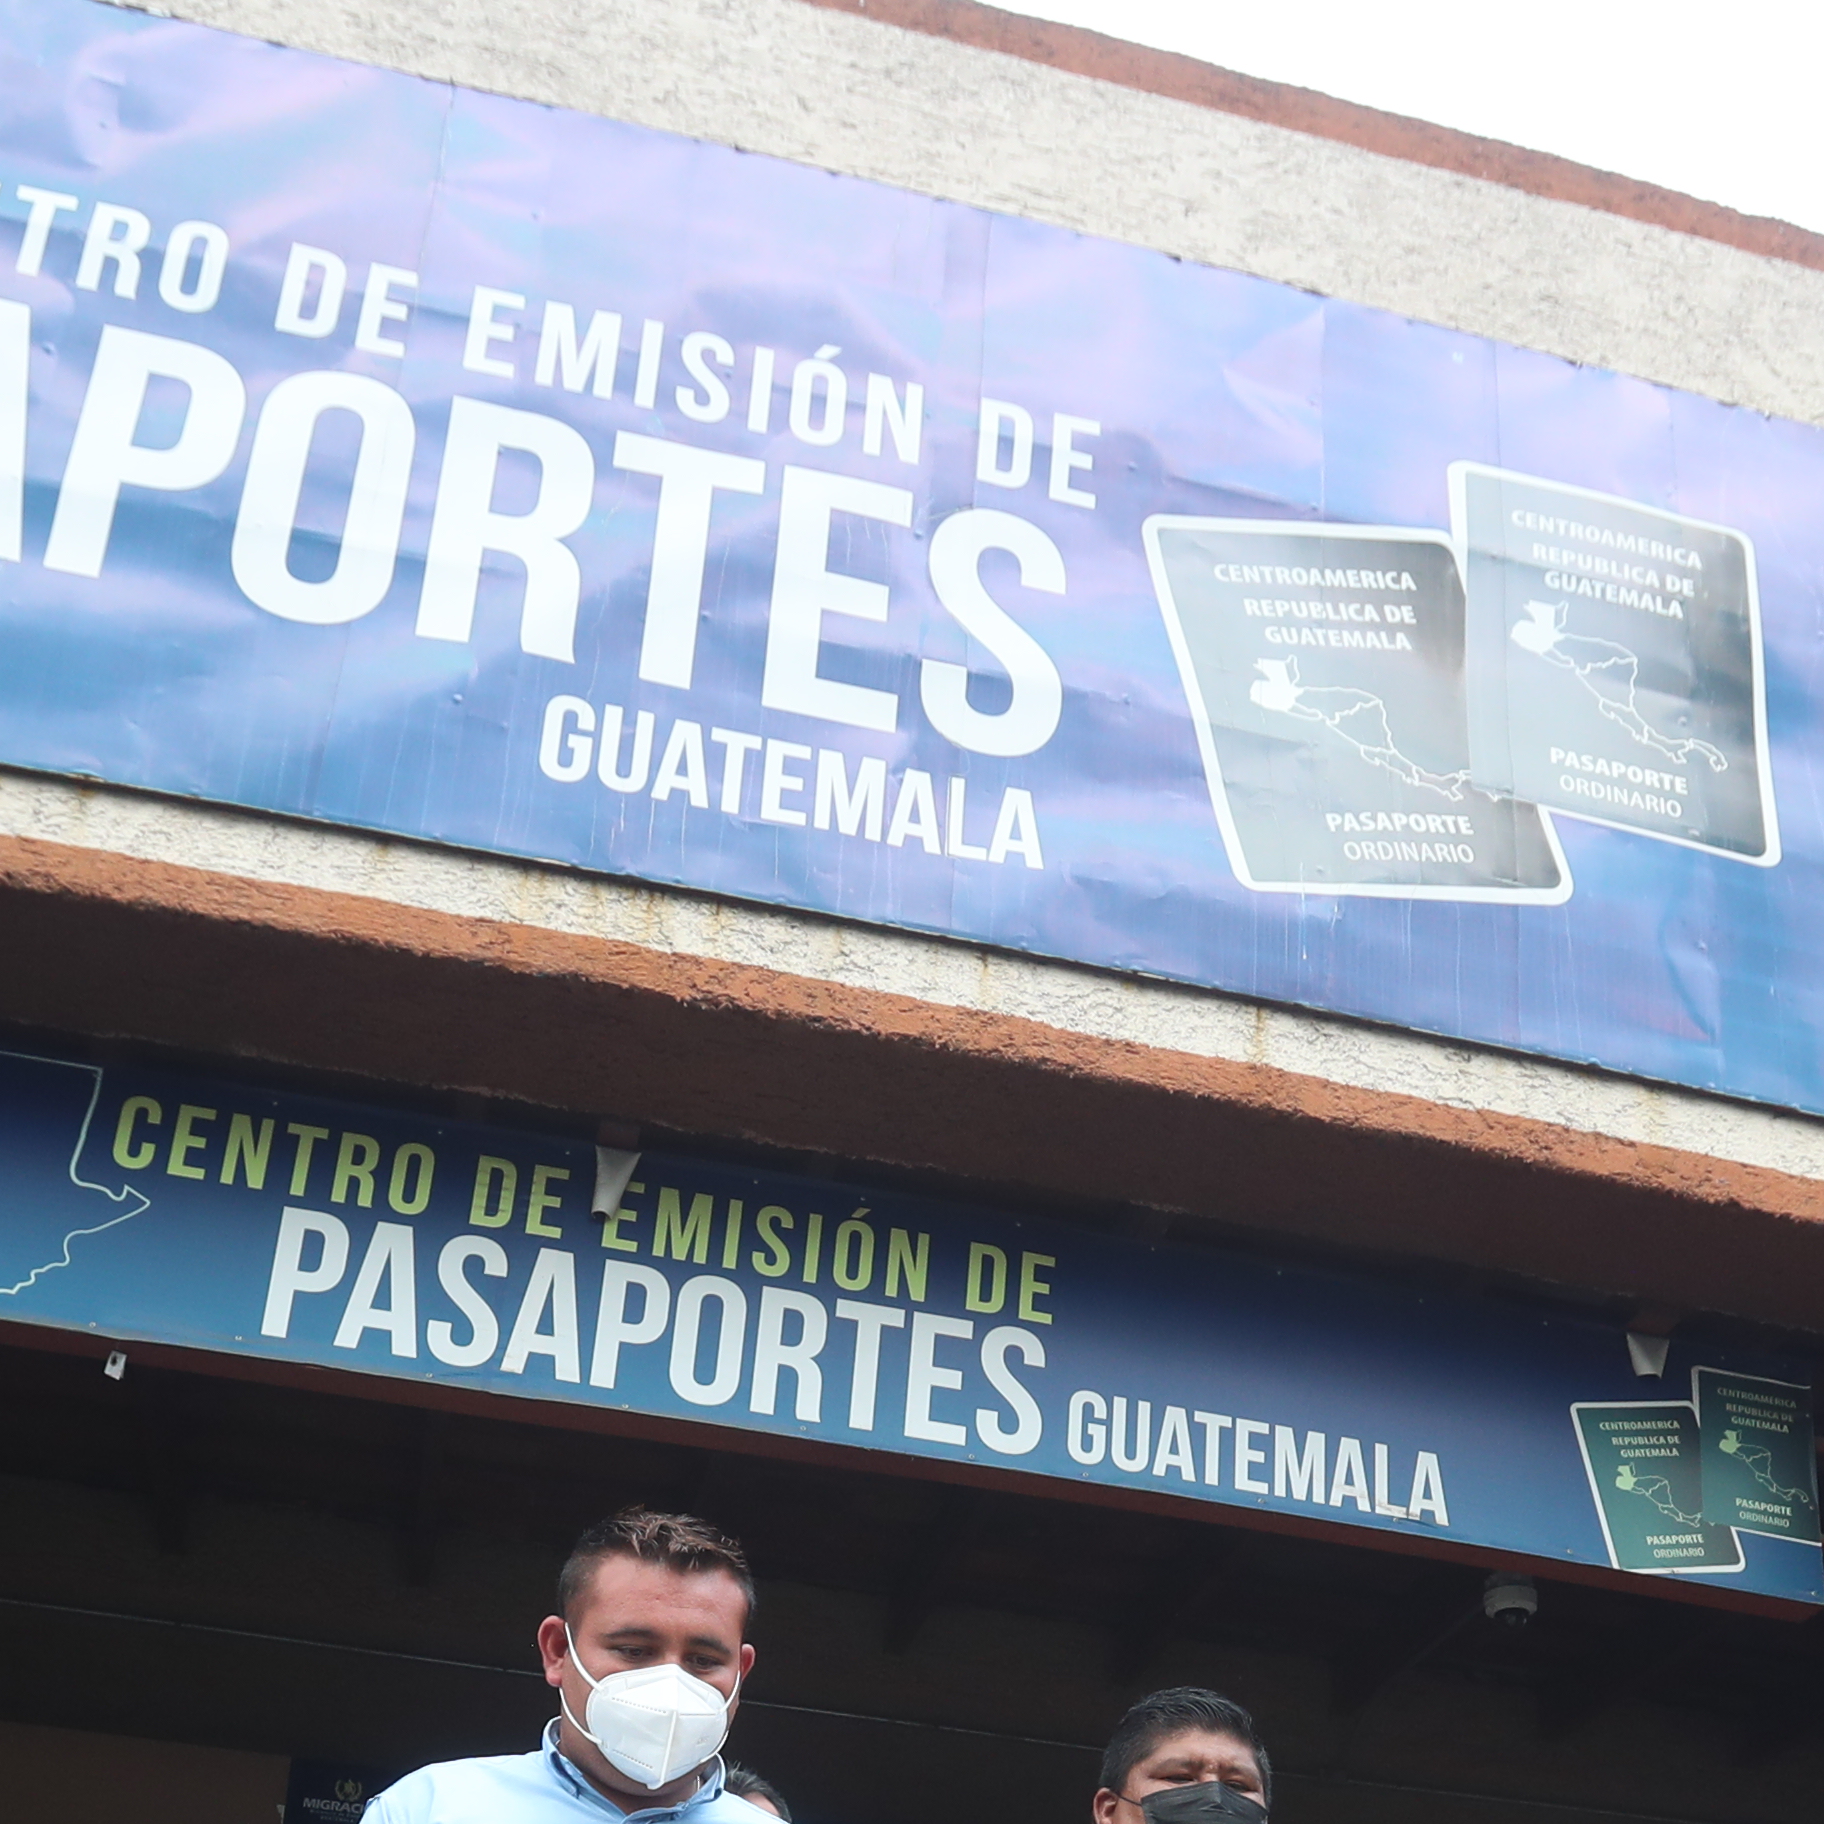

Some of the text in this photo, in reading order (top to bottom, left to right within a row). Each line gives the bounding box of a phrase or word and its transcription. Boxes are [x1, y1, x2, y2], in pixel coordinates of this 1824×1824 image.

[274, 241, 420, 358] DE
[462, 286, 924, 464] EMISIÓN
[976, 398, 1102, 509] DE
[1510, 508, 1703, 570] CENTROAMERICA
[1213, 563, 1417, 592] CENTROAMERICA
[1532, 542, 1695, 599] REPUBLICA DE
[1543, 571, 1684, 620] GUATEMALA
[1243, 597, 1418, 626] REPUBLICA DE
[1264, 625, 1413, 652] GUATEMALA
[539, 694, 1043, 870] GUATEMALA
[1550, 746, 1688, 795] PASAPORTE
[1558, 773, 1683, 819] ORDINARIO
[1326, 812, 1474, 837] PASAPORTE
[1342, 840, 1475, 865] ORDINARIO
[112, 1095, 1057, 1327] CENTRO DE EMISIÓN DE
[259, 1205, 1049, 1456] PASAPORTES
[1717, 1387, 1797, 1409] CENTROAMERICA
[1599, 1420, 1680, 1430] CENTROAMERICA
[1731, 1416, 1789, 1434] GUATEMALA
[1611, 1435, 1681, 1446] REPUBLICA DE
[1620, 1448, 1679, 1458] GUATEMALA
[1065, 1388, 1451, 1529] GUATEMALA
[1735, 1498, 1792, 1516] PASAPORTE
[1739, 1511, 1790, 1528] ORDINARIO
[1646, 1534, 1704, 1545] PASAPORTE
[1653, 1547, 1705, 1558] ORDINARIO
[303, 1797, 364, 1814] MIGRACI
